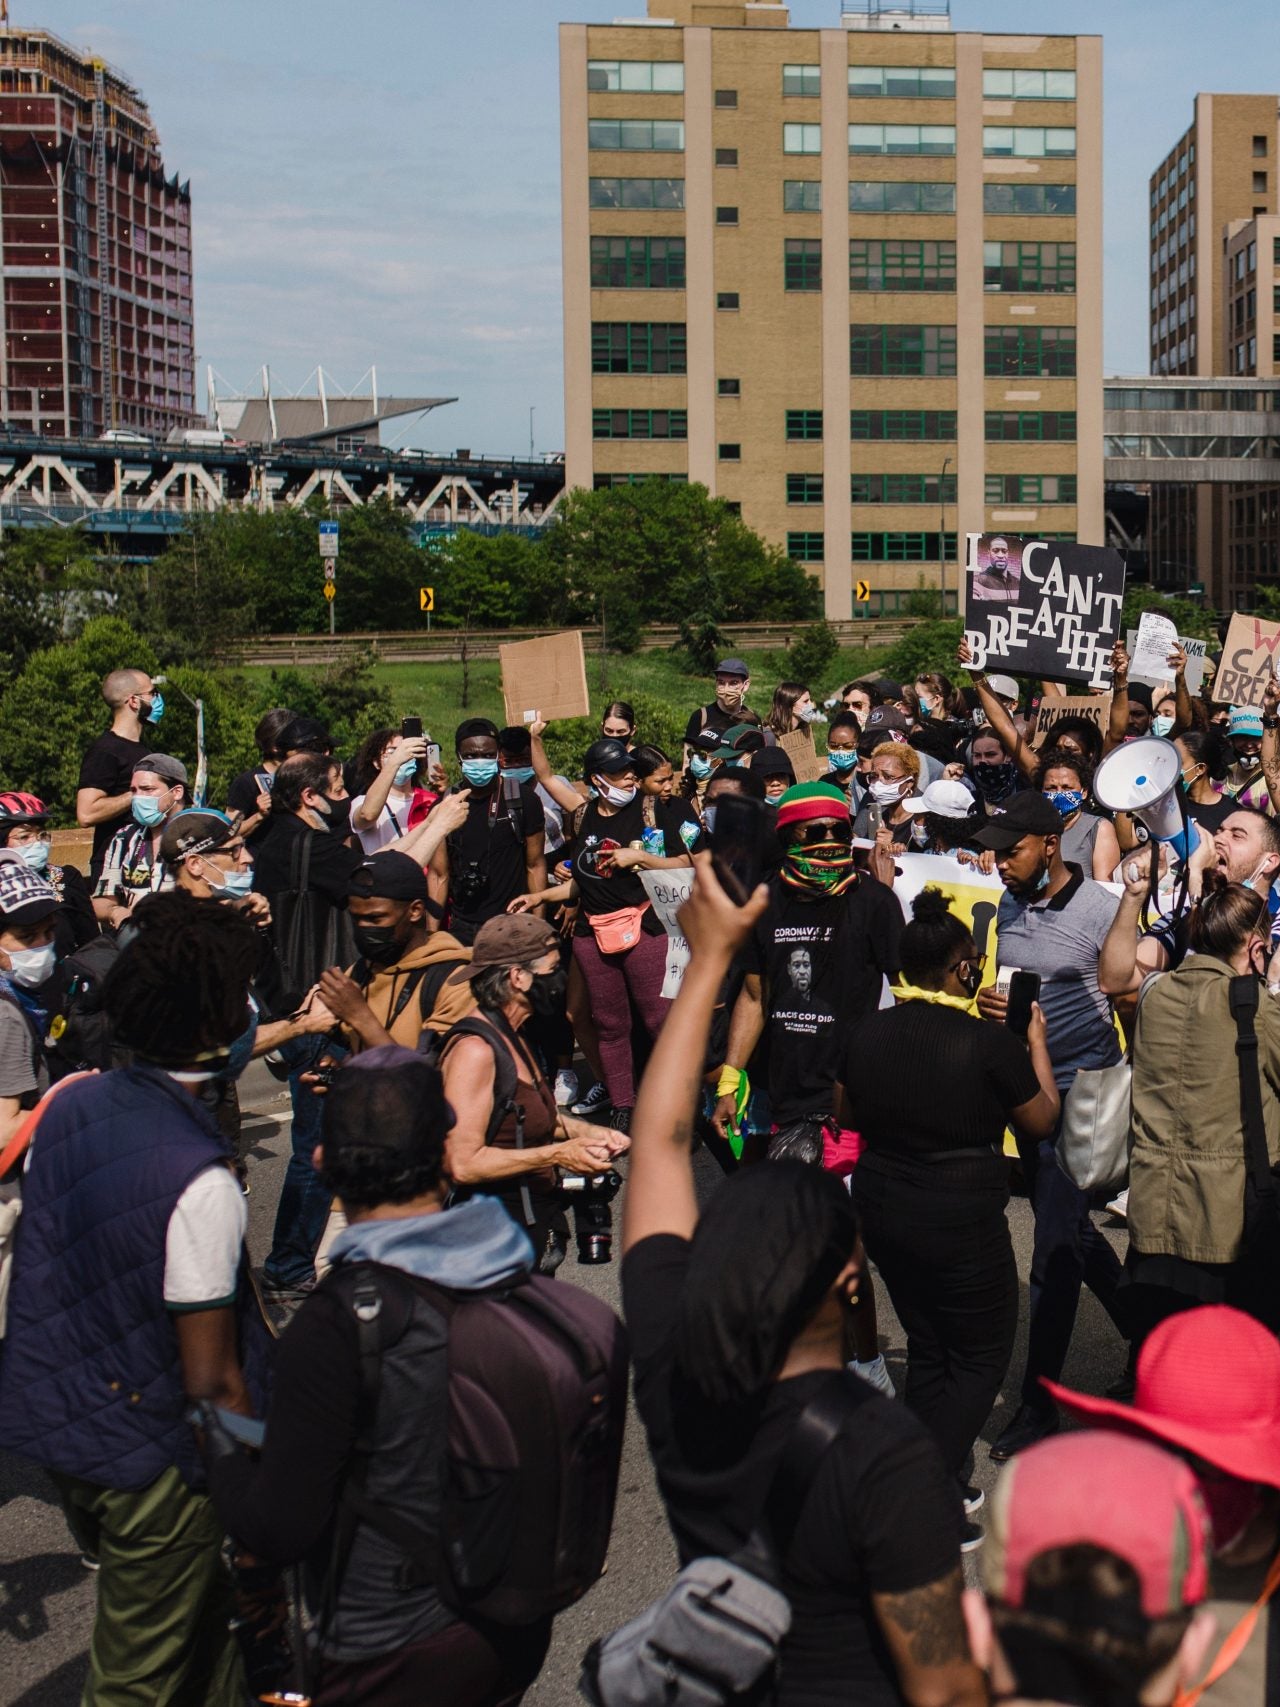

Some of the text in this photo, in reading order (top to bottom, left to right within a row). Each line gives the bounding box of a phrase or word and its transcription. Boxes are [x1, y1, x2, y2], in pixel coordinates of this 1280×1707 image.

[966, 533, 983, 572] I
[1022, 542, 1123, 635] CAN'T
[961, 597, 1114, 690] BREATHE
[1218, 669, 1265, 709] BRE
[654, 885, 692, 904] BLAC
[798, 1013, 816, 1021] COP
